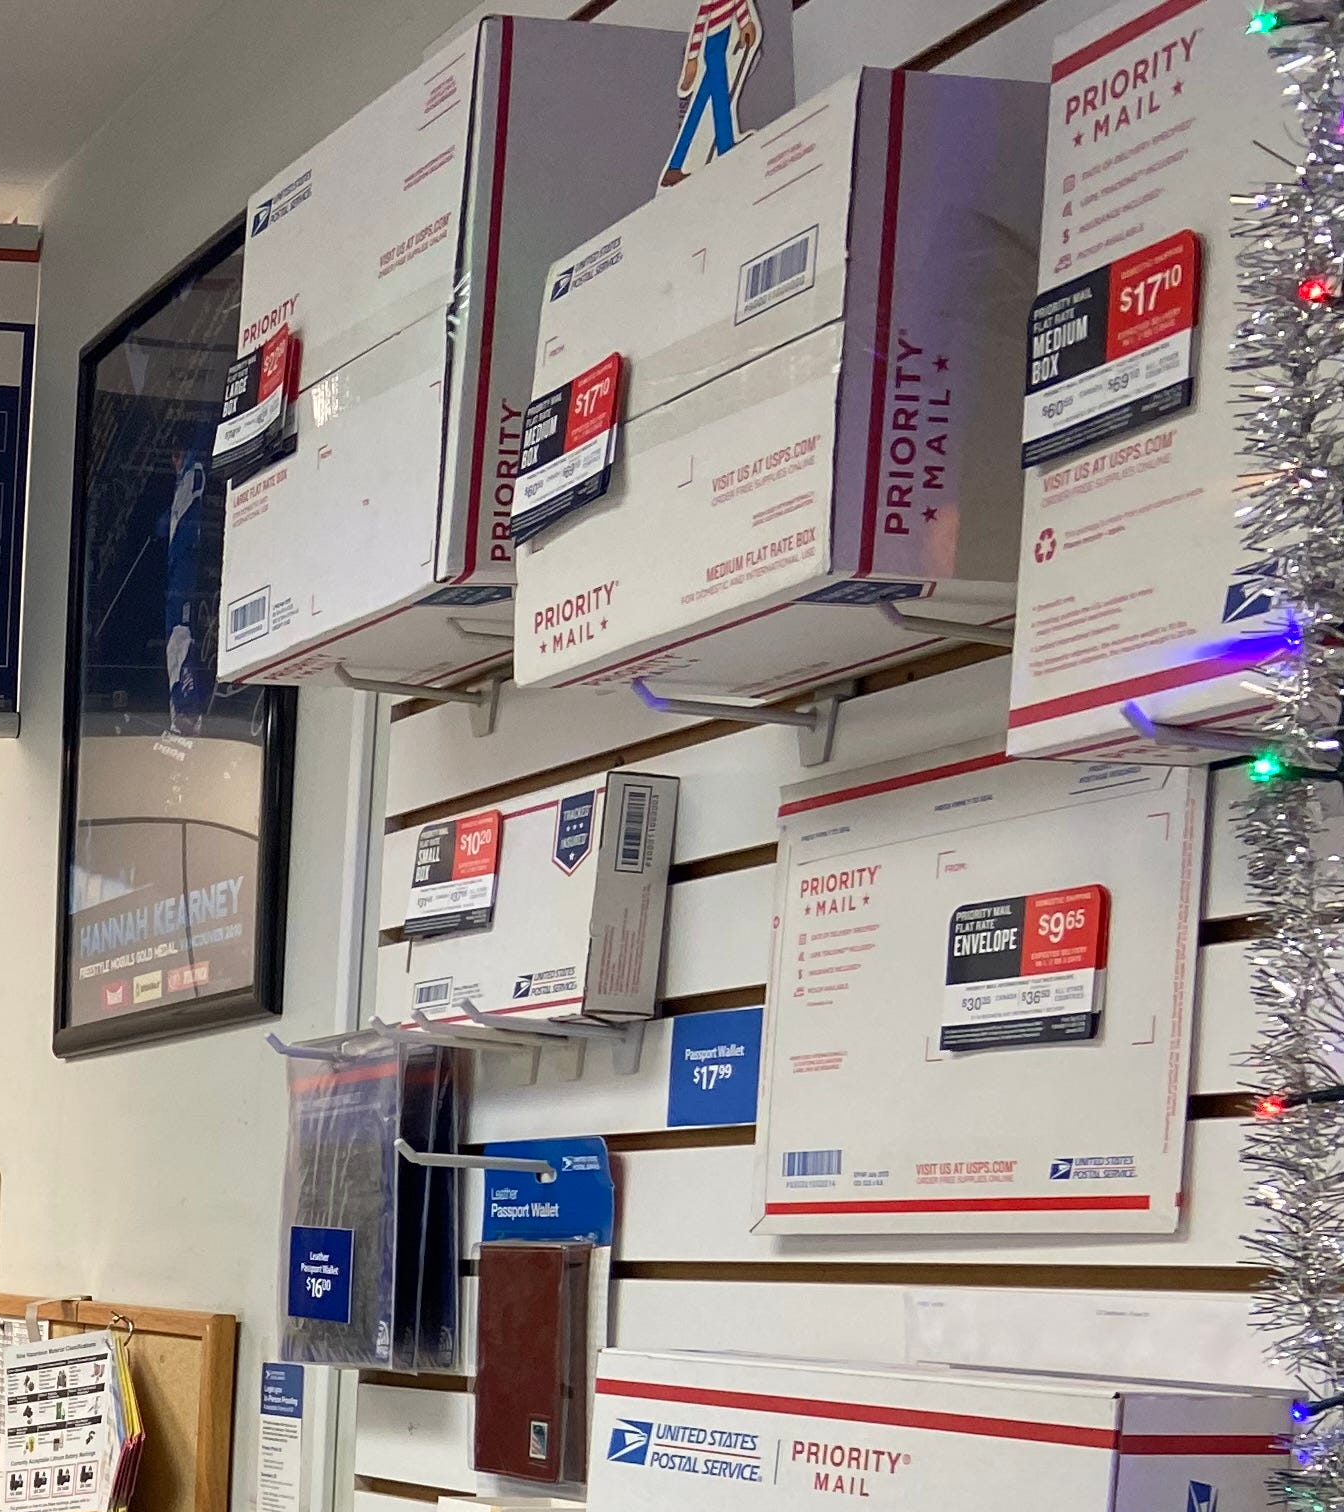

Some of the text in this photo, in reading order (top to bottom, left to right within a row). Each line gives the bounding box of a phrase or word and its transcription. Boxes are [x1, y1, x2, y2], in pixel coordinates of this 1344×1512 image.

[1065, 28, 1198, 125] PRIORITY
[1094, 91, 1161, 142] MAIL
[1033, 315, 1088, 359] MEDIUM
[1032, 352, 1059, 385] BOX
[884, 337, 923, 535] PRIORITY
[922, 389, 951, 489] MAIL
[491, 402, 522, 562] PRIORITY
[534, 581, 615, 634] PRIORITY
[553, 621, 594, 653] MAIL
[801, 866, 879, 898] PRIORITY
[80, 876, 244, 958] HANNAH KEARNEY
[816, 895, 856, 916] MAIL
[954, 928, 1018, 957] ENVELOPE
[685, 1044, 744, 1062] Passport Wallet
[491, 1187, 518, 1201] Leather
[491, 1203, 559, 1220] Passport Wallet
[656, 1423, 759, 1450] UNITED STATES
[650, 1452, 762, 1482] POSTAL SERVICE
[814, 1472, 870, 1497] MAIL
